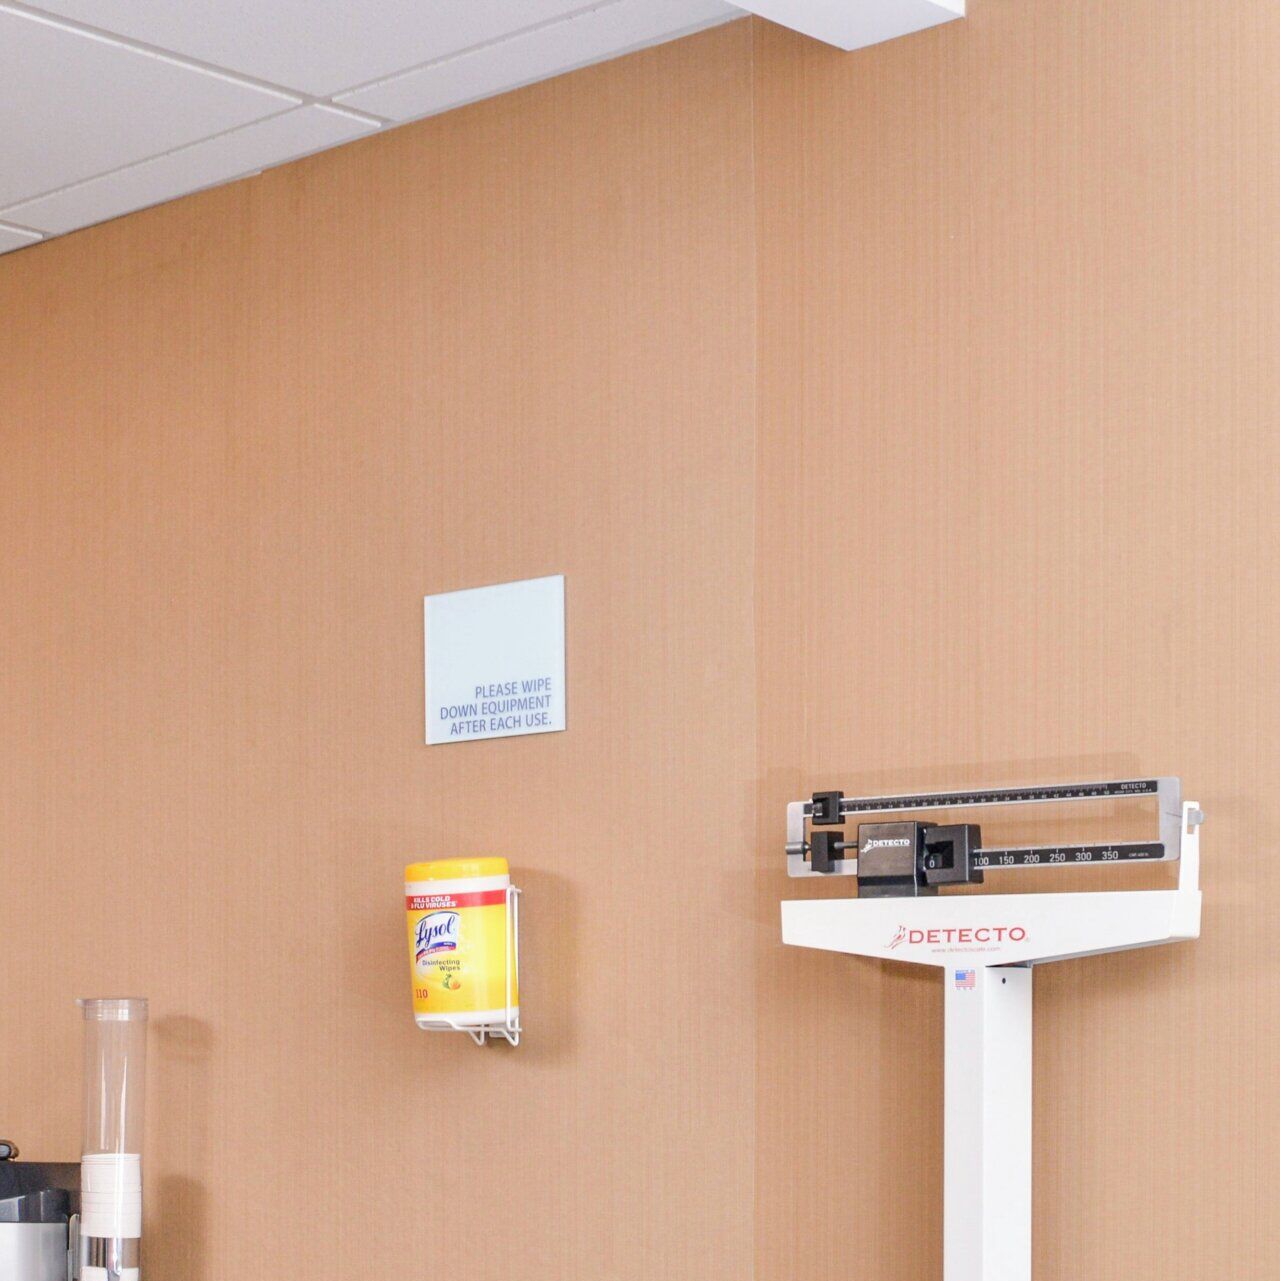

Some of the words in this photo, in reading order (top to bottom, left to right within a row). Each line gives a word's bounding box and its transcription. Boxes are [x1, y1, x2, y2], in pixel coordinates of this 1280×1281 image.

[475, 681, 518, 699] PLEASE
[521, 677, 552, 693] WIPE
[440, 703, 478, 720] DOWN
[481, 695, 552, 715] EQUIPMENT
[450, 719, 487, 735] AFTER
[490, 714, 522, 731] EACH
[525, 712, 552, 727] USE.
[872, 838, 911, 847] DETECTO
[973, 857, 989, 866] 100
[999, 855, 1015, 865] 150
[1023, 854, 1040, 864] 200
[1049, 853, 1066, 863] 250
[1075, 852, 1092, 861] 300
[1102, 851, 1119, 860] 350
[425, 901, 456, 909] VIRUSES
[415, 915, 455, 948] Lysol
[909, 927, 1026, 944] DETECTO
[416, 988, 428, 999] 110
